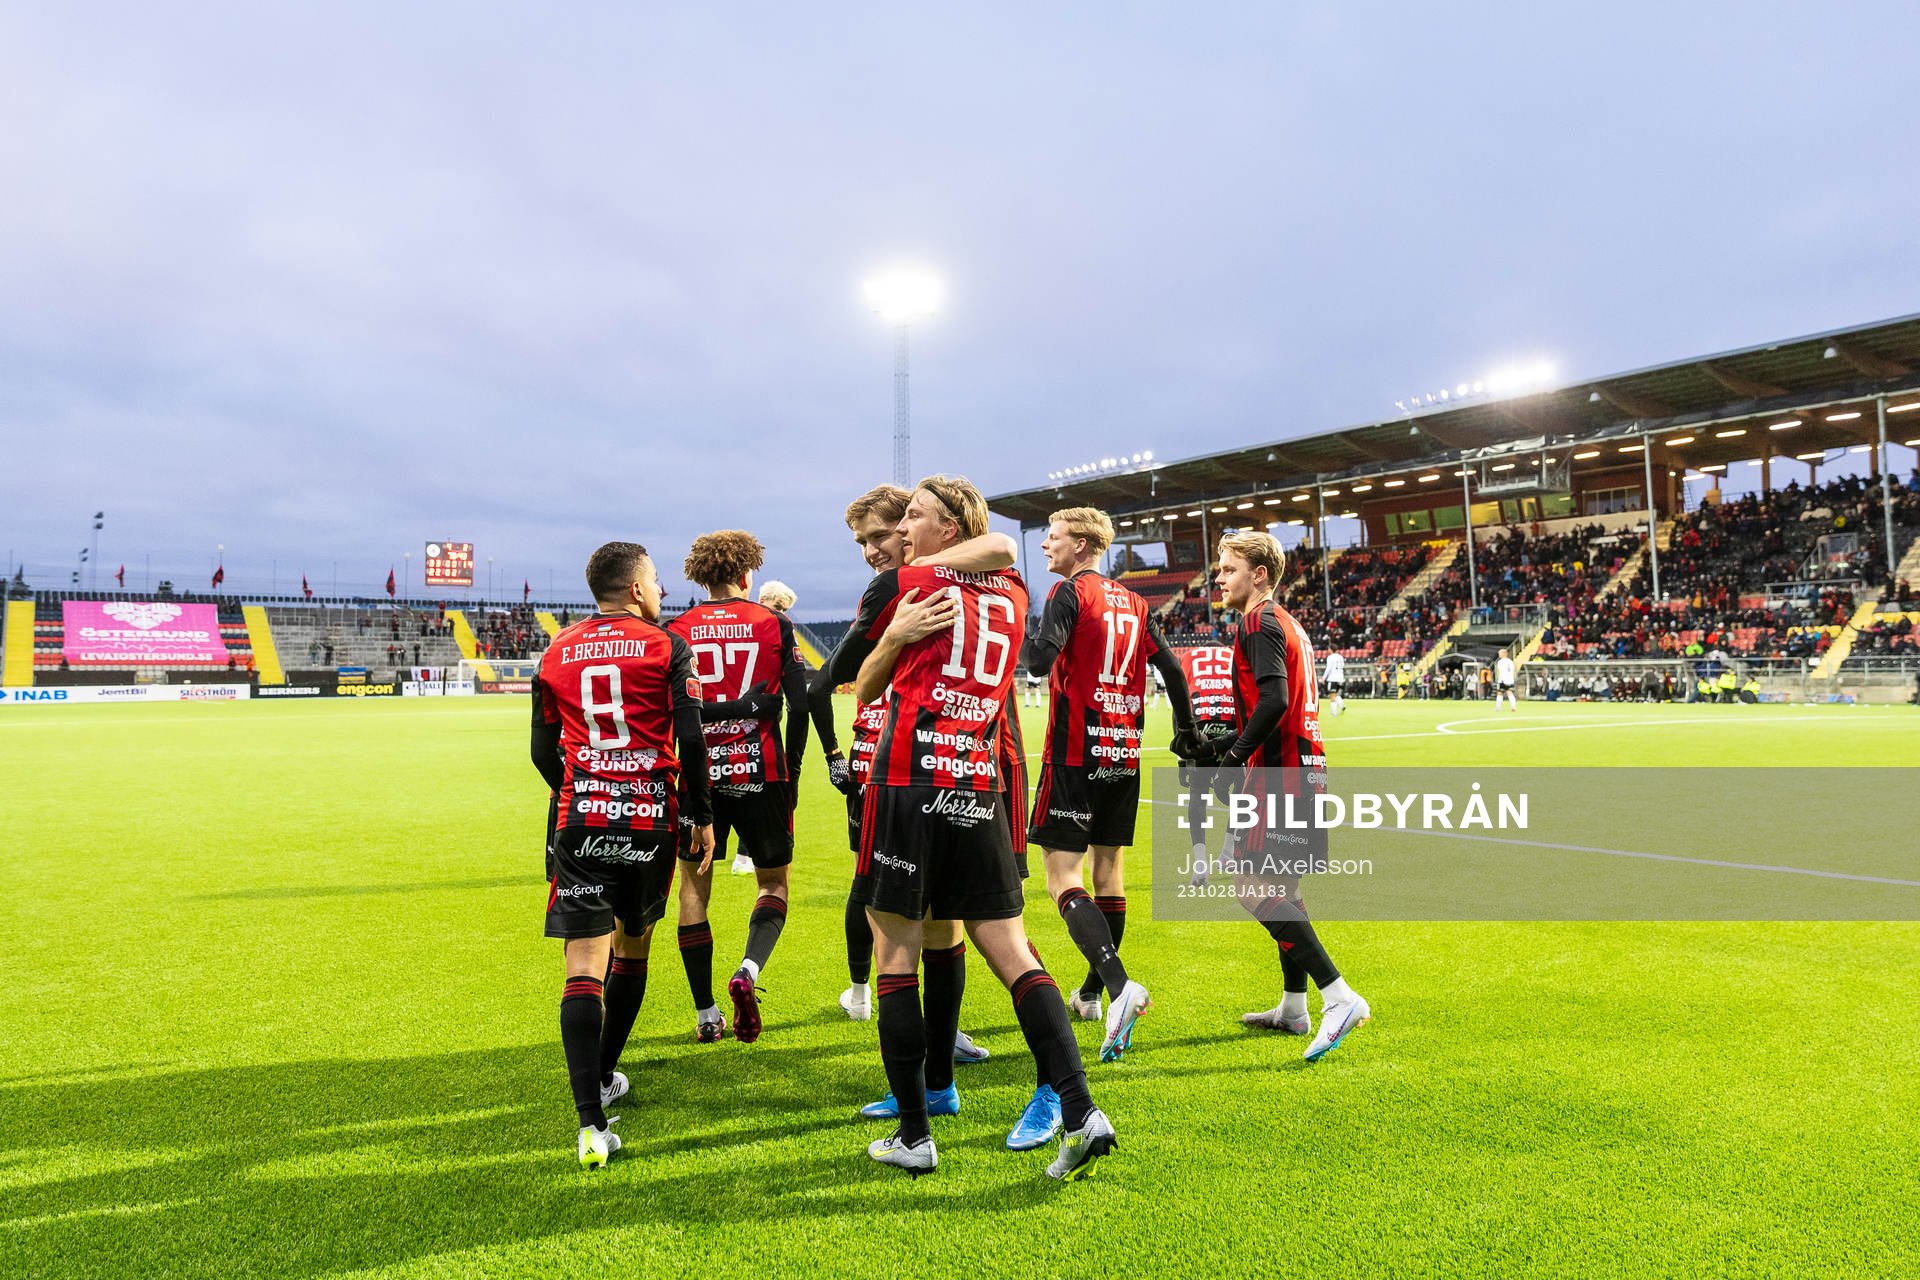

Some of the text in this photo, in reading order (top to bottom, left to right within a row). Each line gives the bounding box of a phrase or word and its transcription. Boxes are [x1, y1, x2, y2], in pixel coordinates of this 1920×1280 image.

[79, 627, 210, 638] ÖSTERSUND
[690, 623, 753, 641] GHANOUM
[942, 586, 1014, 687] 16
[561, 639, 647, 664] E.BRENDON
[1098, 610, 1138, 685] 17
[1191, 647, 1234, 678] 29
[14, 690, 68, 700] INAB
[336, 684, 395, 697] engcon
[932, 682, 979, 710] ÖSTER
[1093, 688, 1125, 704] ÖSTER
[580, 664, 631, 750] 8
[860, 707, 885, 719] ÖST
[941, 703, 986, 722] SUND
[867, 718, 883, 729] SU
[916, 729, 996, 756] wangeskog
[577, 746, 633, 762] ÖSTER
[590, 760, 639, 772] SUND
[709, 759, 759, 780] gcon
[921, 755, 996, 778] engcon
[574, 779, 666, 797] wangeskog
[577, 800, 665, 820] engcon
[922, 789, 995, 820] Norrland
[574, 835, 659, 862] Norrland
